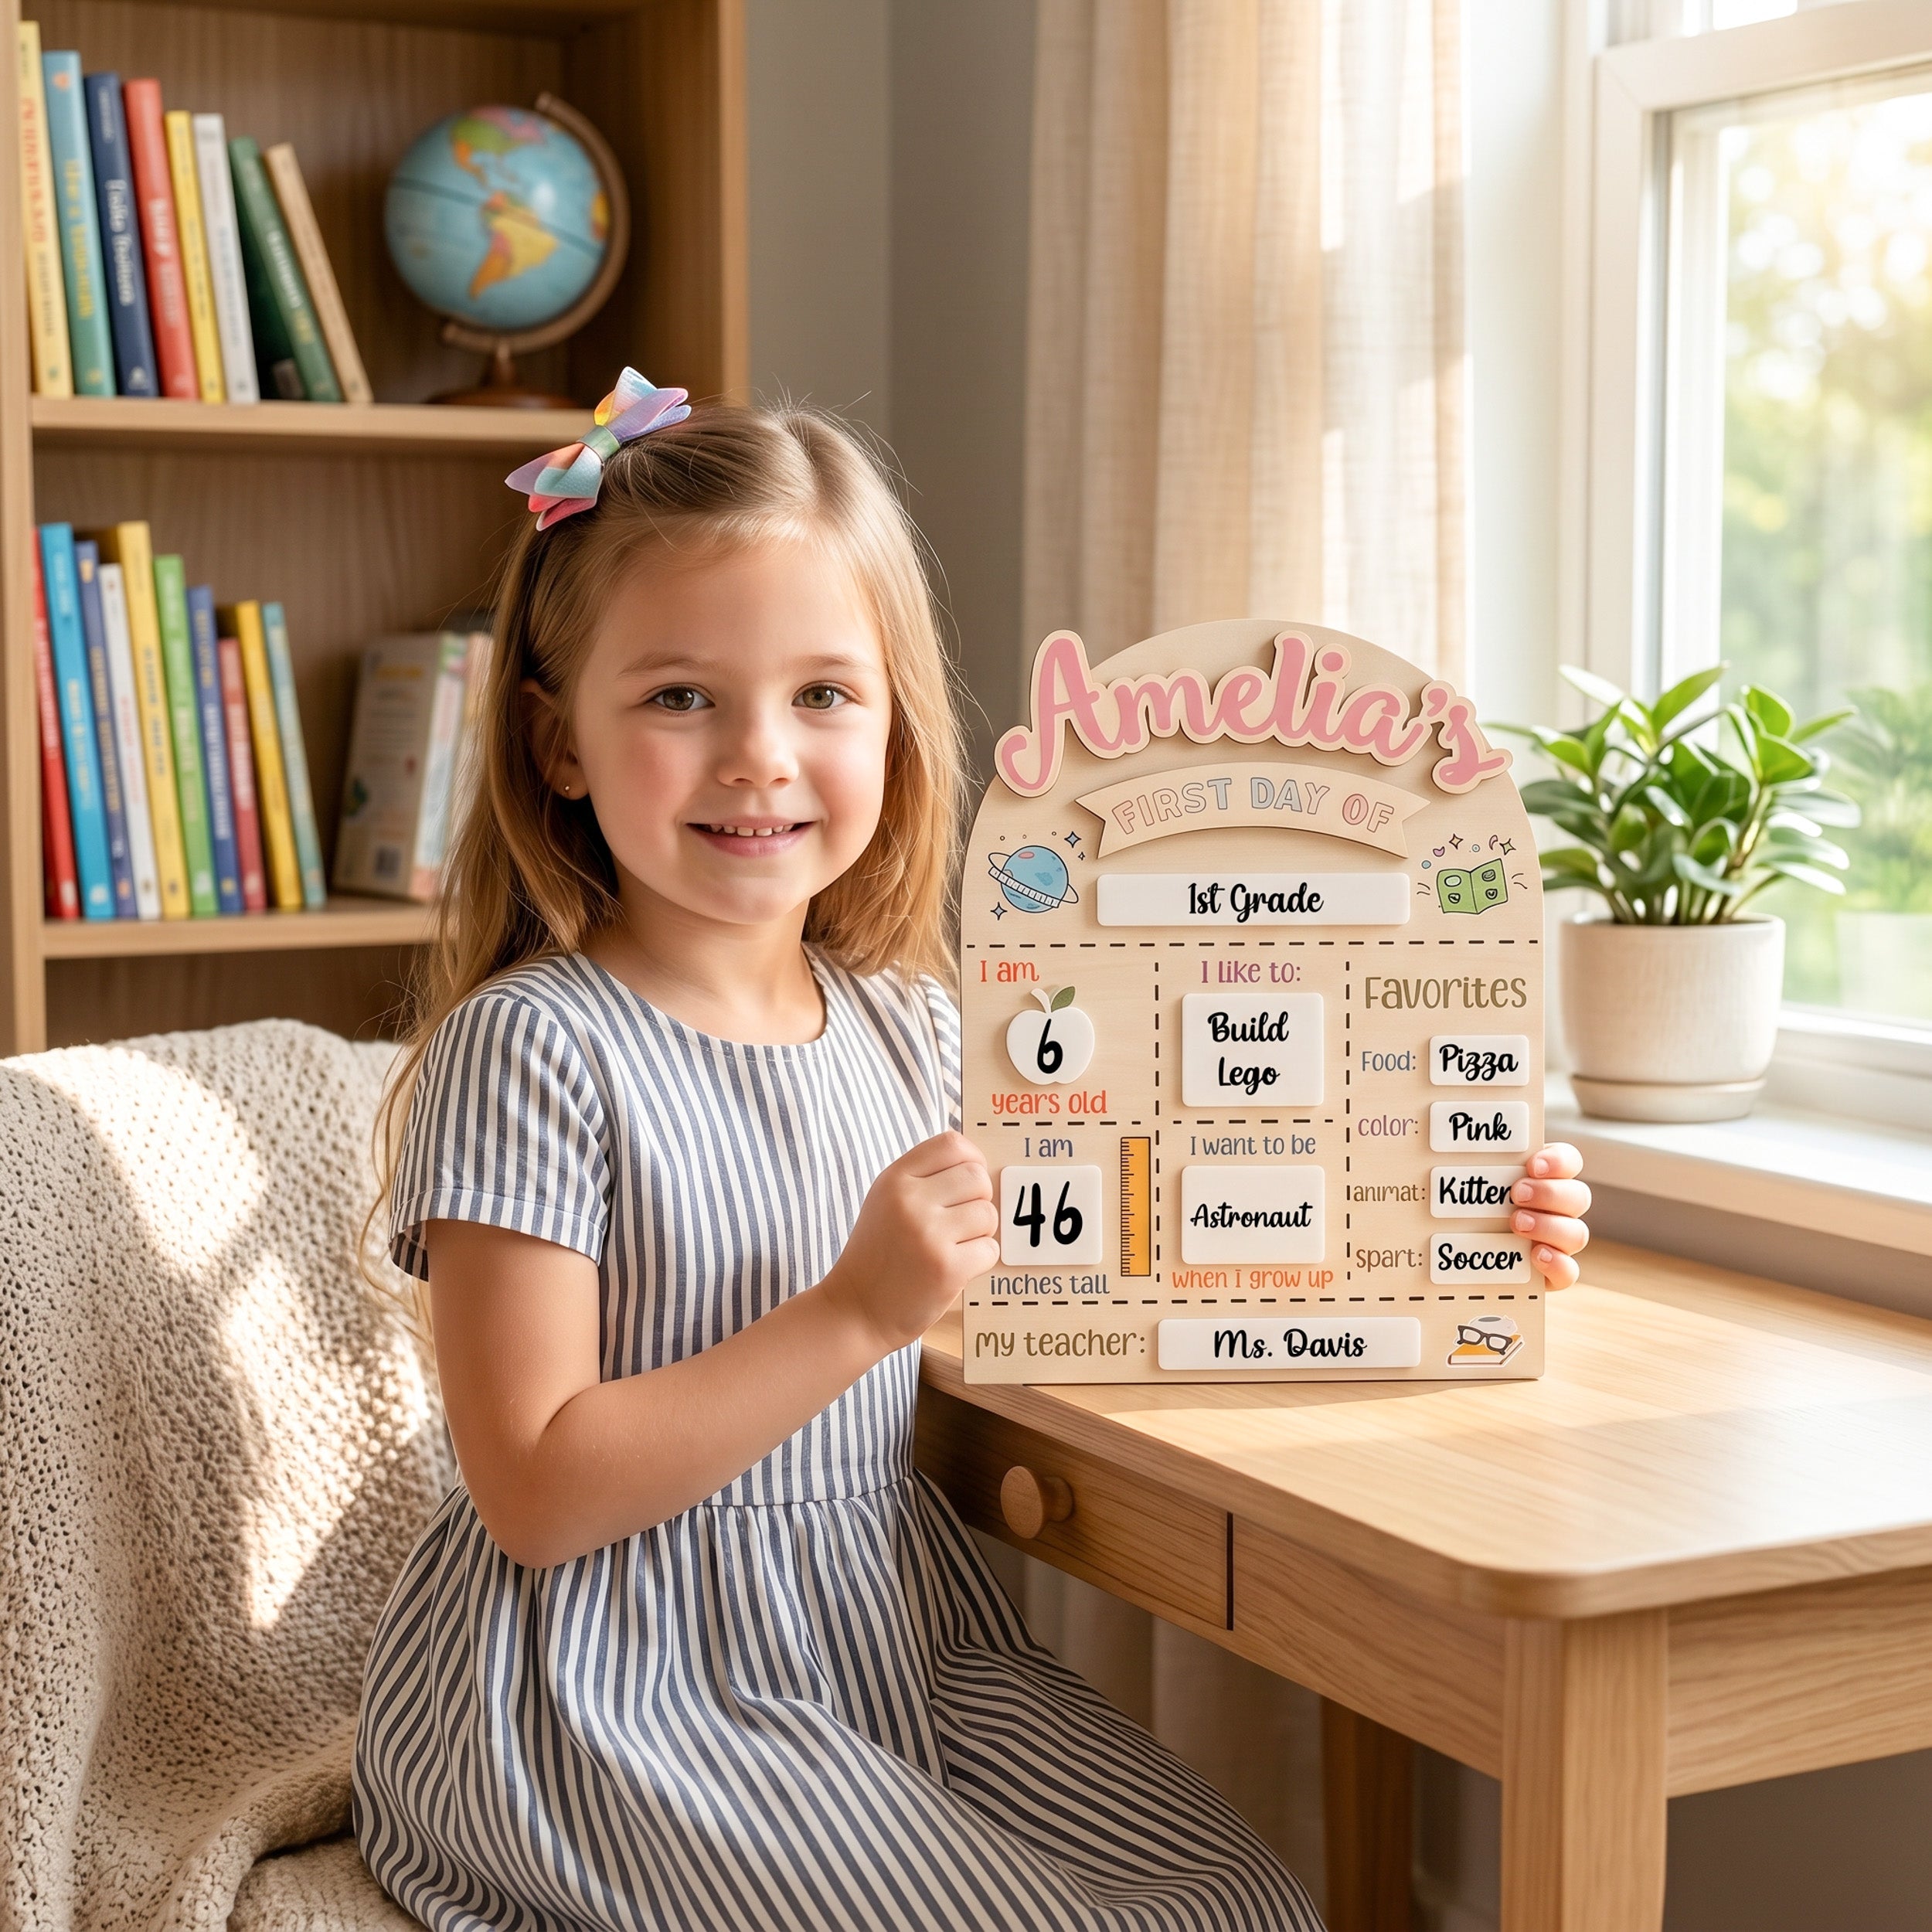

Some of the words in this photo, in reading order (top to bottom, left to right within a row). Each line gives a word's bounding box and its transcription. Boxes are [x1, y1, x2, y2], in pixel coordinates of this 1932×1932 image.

[1001, 636, 1506, 791] Amelia's
[1111, 777, 1232, 835] FIRST
[1250, 777, 1330, 815] DAY
[1342, 794, 1395, 833] OF
[1188, 883, 1226, 914] 1st
[1230, 882, 1325, 923] Grade
[980, 960, 988, 982] I
[996, 961, 1040, 983] am
[1201, 961, 1209, 983] I
[1218, 961, 1261, 983] like
[1269, 961, 1301, 984] to:
[1365, 976, 1528, 1009] Favorites
[1207, 1011, 1290, 1043] Build
[1037, 1019, 1063, 1074] 6
[1362, 1050, 1417, 1072] Food:
[1439, 1043, 1519, 1082] Pizza
[1218, 1056, 1281, 1096] Lego
[992, 1092, 1061, 1115] years
[1068, 1090, 1108, 1114] old
[1358, 1114, 1419, 1137] color:
[1448, 1111, 1512, 1141] Pink
[1025, 1137, 1031, 1158] I
[1038, 1138, 1073, 1158] am
[1190, 1136, 1197, 1155] I
[1202, 1136, 1257, 1155] want
[1263, 1136, 1285, 1155] to
[1291, 1134, 1316, 1155] be
[1012, 1180, 1083, 1248] 46
[1189, 1201, 1314, 1229] Astronaut
[1355, 1248, 1423, 1274] spart:
[1437, 1243, 1523, 1271] Soccer
[990, 1274, 1063, 1295] inches
[1069, 1273, 1111, 1294] tall
[1172, 1270, 1228, 1289] when
[1250, 1270, 1301, 1290] grow
[1308, 1270, 1334, 1290] up
[1023, 1328, 1146, 1357] teacher:
[1214, 1329, 1274, 1359] Ms.
[1283, 1328, 1368, 1358] Davis
